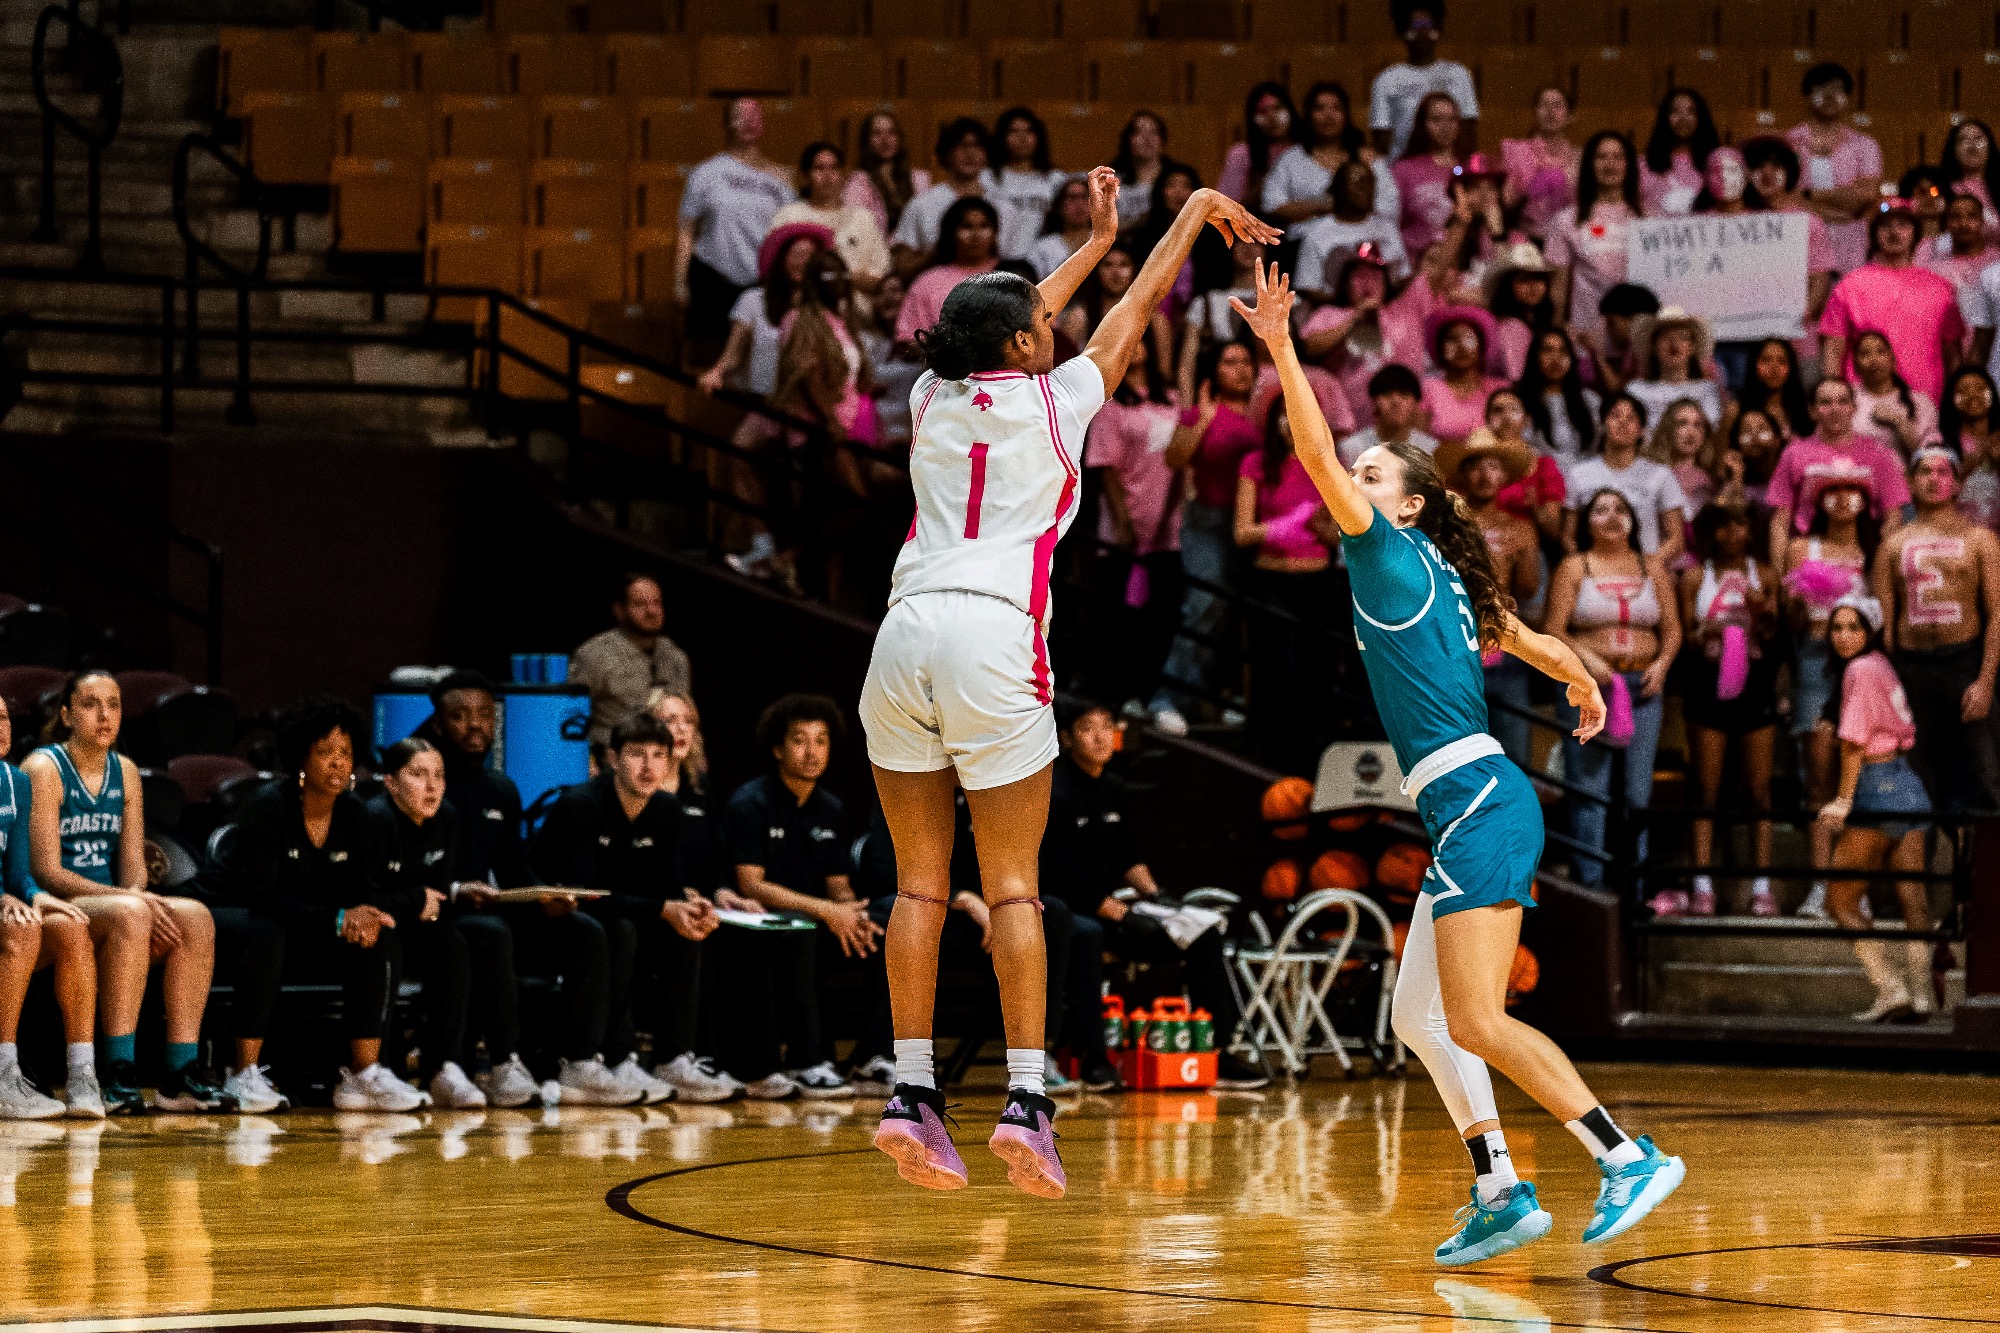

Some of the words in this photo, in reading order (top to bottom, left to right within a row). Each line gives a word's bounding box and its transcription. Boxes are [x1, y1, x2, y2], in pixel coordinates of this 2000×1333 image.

[1639, 222, 1709, 252] WHAT
[1718, 219, 1783, 247] EVEN
[1706, 253, 1724, 274] A
[964, 442, 989, 539] 1
[1902, 537, 1965, 624] E
[1594, 577, 1643, 650] T
[60, 813, 122, 837] COASTA
[73, 840, 108, 867] 22
[1180, 1057, 1199, 1083] G
